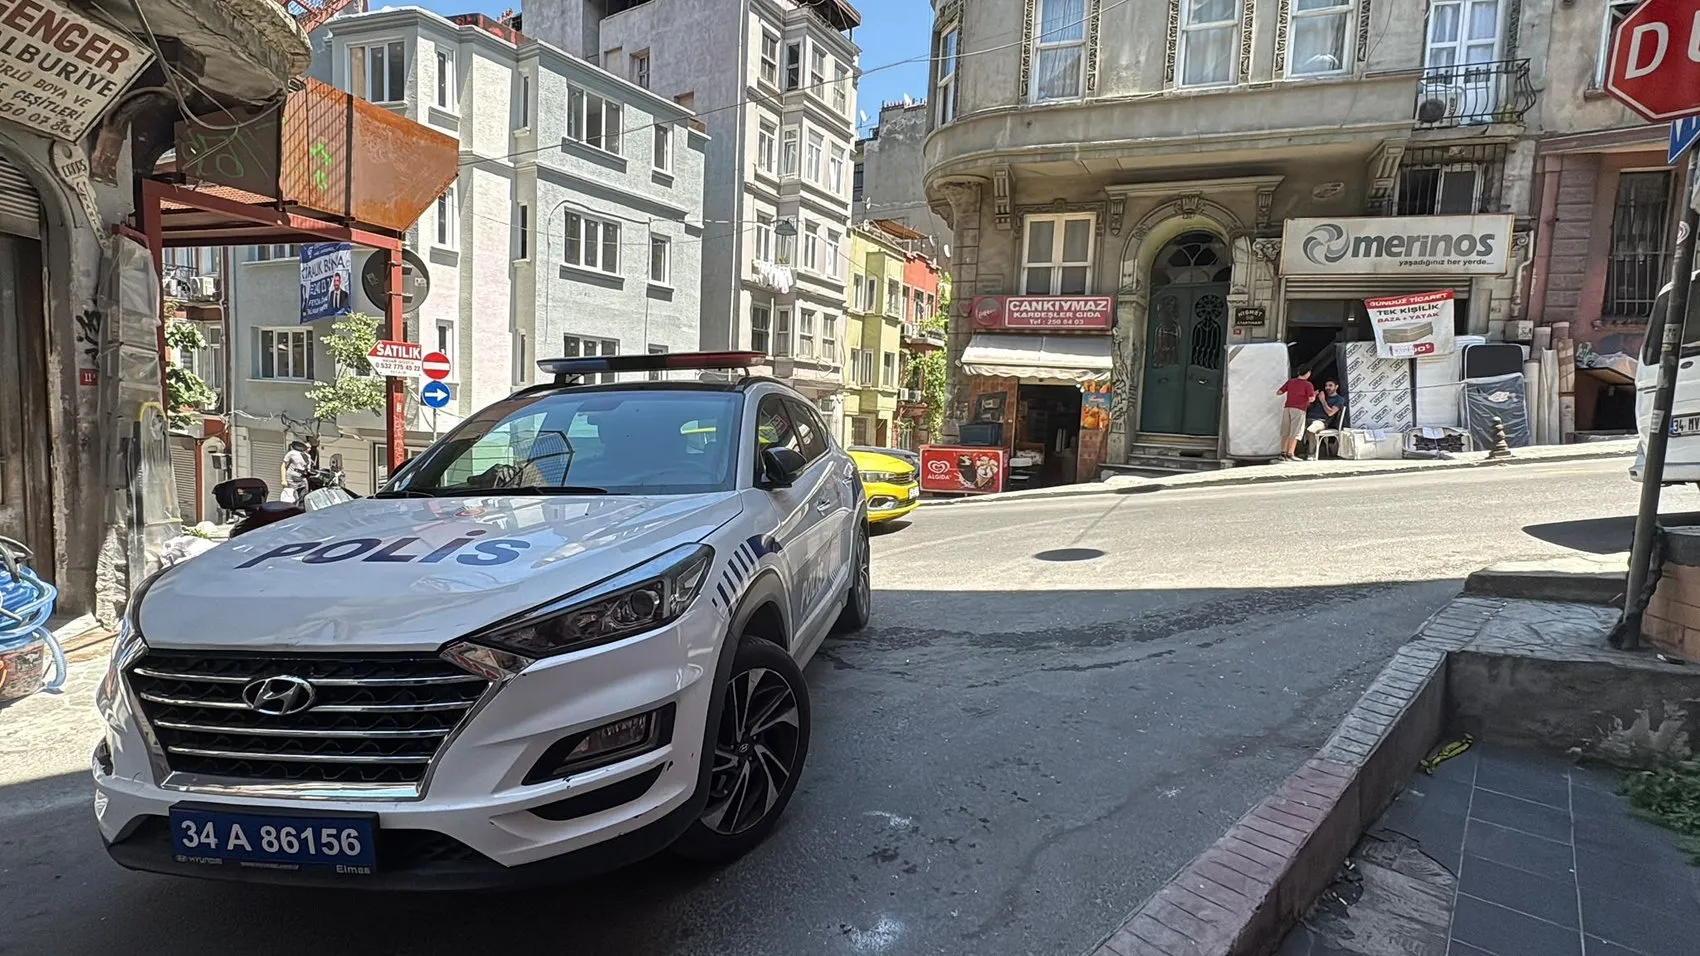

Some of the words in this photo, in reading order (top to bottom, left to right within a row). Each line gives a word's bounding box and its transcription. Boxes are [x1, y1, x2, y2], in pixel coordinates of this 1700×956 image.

[0, 0, 130, 74] ENGER
[1625, 10, 1700, 80] D
[0, 30, 118, 98] LBURİYE
[33, 79, 68, 100] BOYA
[74, 95, 92, 108] VE
[0, 99, 26, 117] 50
[28, 113, 51, 126] 07
[1351, 234, 1496, 258] merinos
[1010, 301, 1107, 311] CANKIYMAZ
[1400, 304, 1440, 314] KİŞİLİK
[1409, 312, 1440, 320] YATAK
[376, 344, 421, 359] SATILIK
[1673, 419, 1683, 432] 34
[233, 529, 531, 569] POLİS
[181, 820, 219, 849] 34
[227, 823, 252, 851] A
[260, 825, 361, 857] 86156
[336, 864, 371, 875] Elmas
